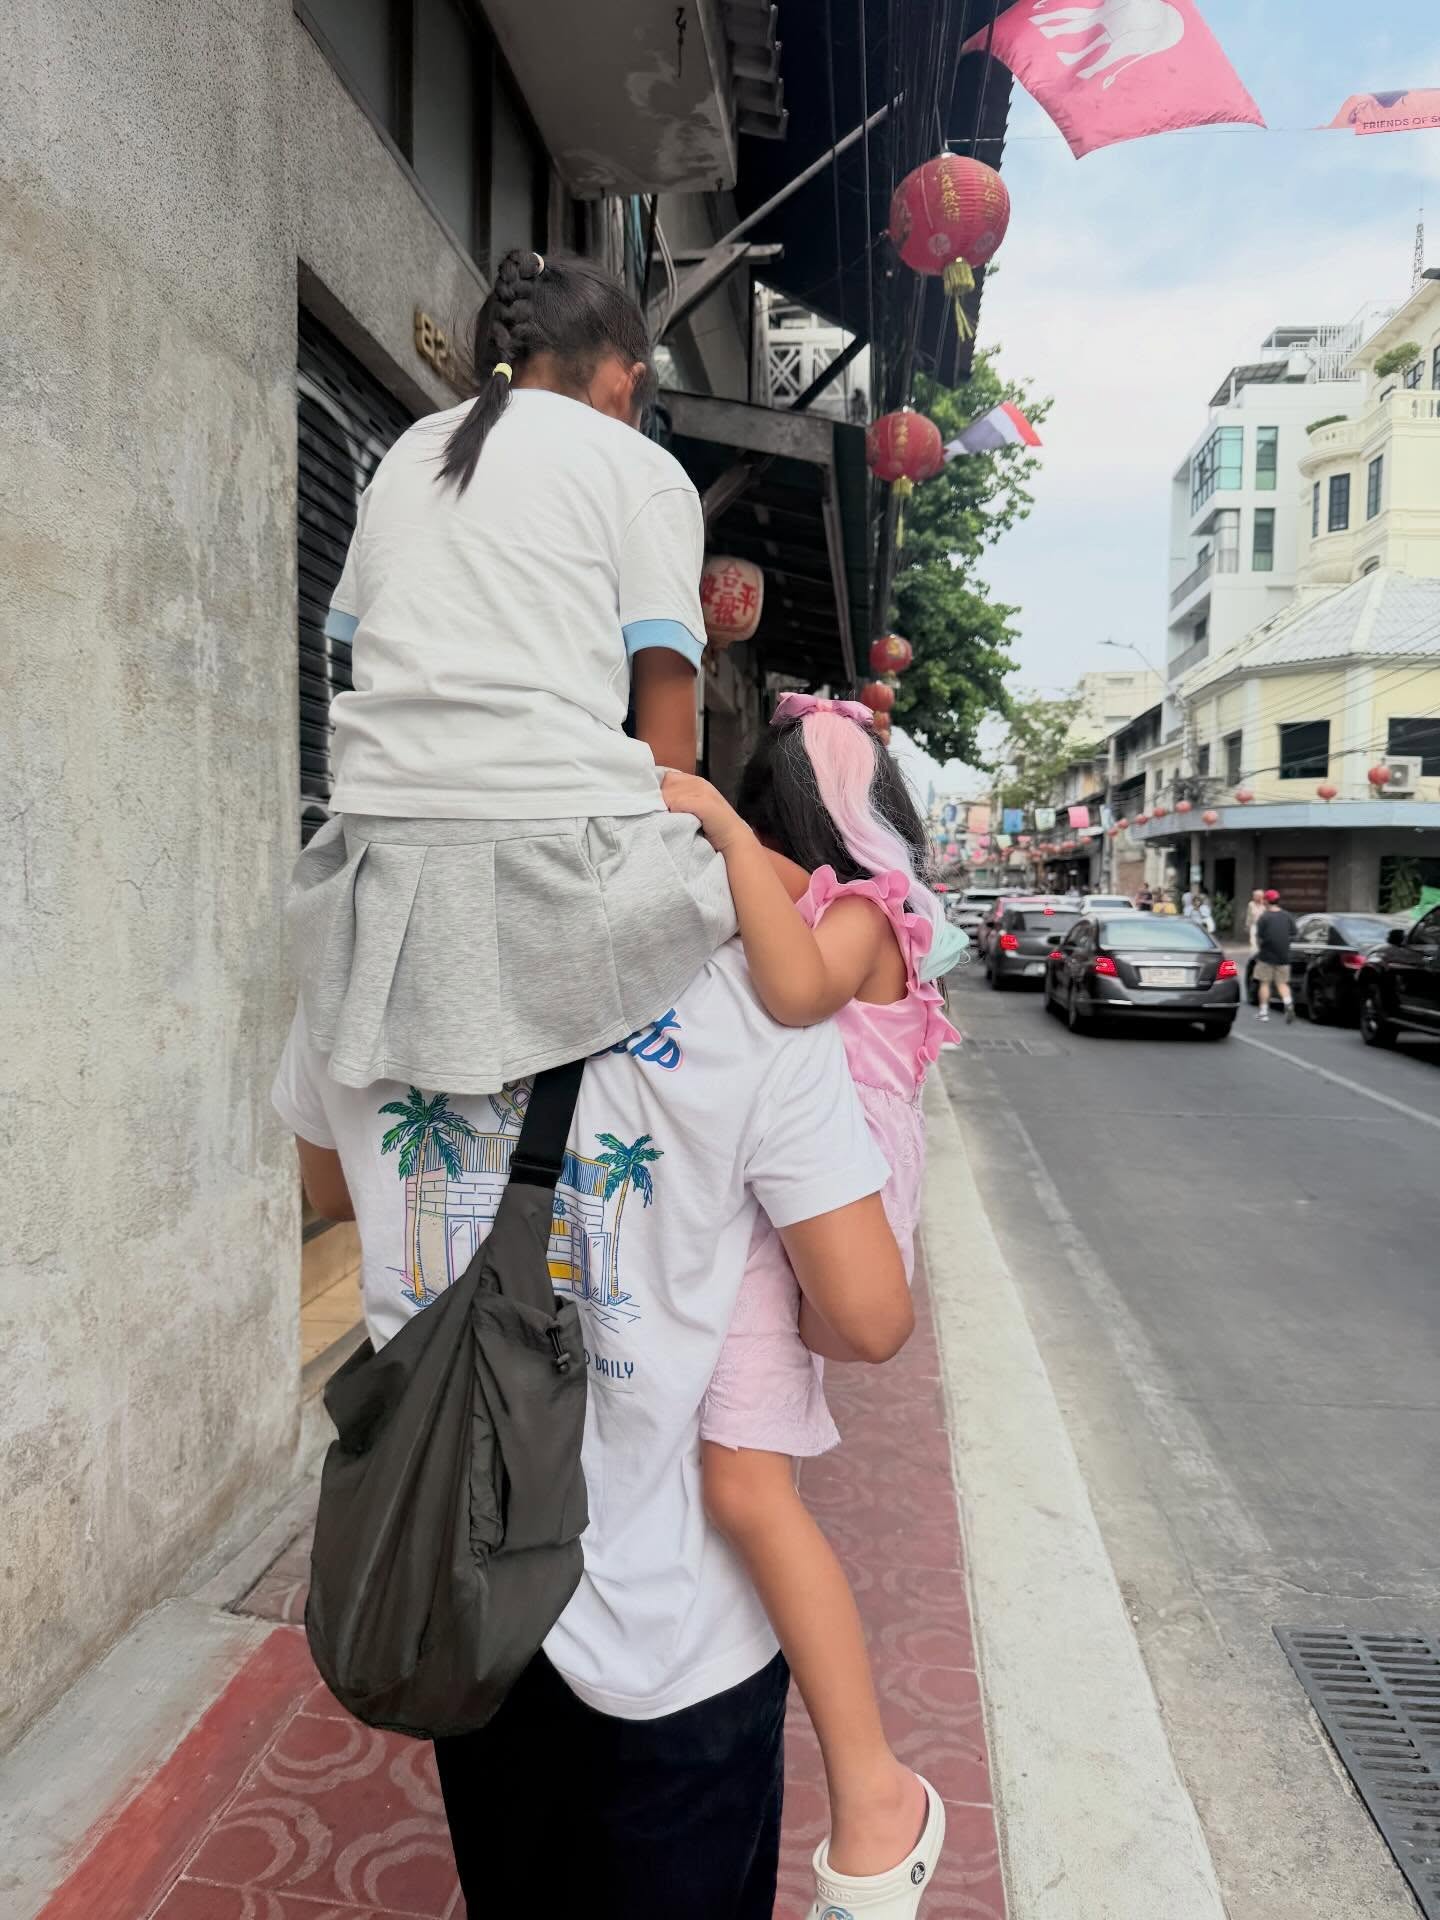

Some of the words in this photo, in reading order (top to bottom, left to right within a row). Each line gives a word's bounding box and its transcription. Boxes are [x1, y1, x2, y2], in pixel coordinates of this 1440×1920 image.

[1362, 119, 1409, 129] FRIENDS
[1412, 117, 1428, 125] OF
[595, 1353, 634, 1379] DAILY
